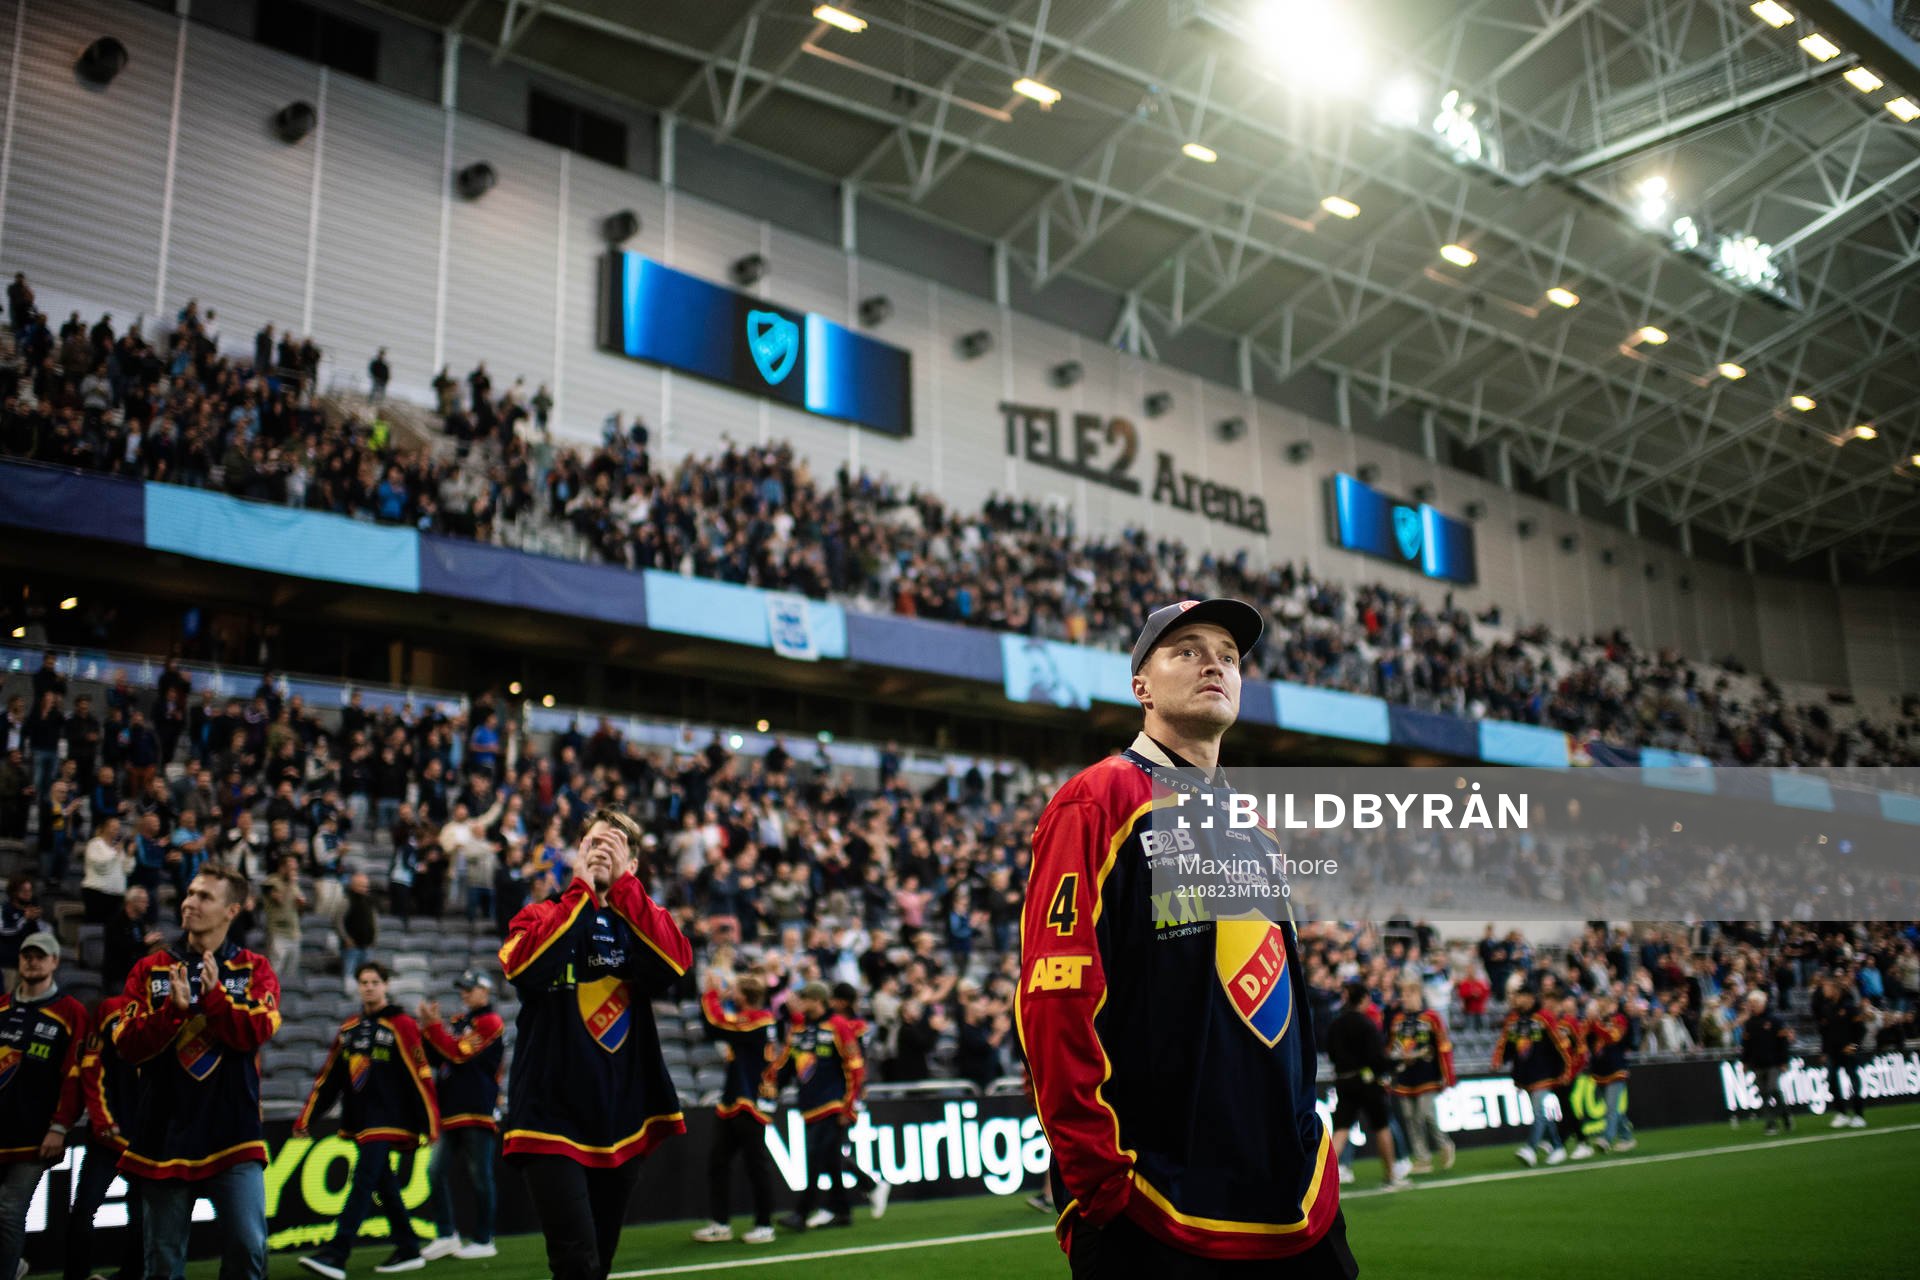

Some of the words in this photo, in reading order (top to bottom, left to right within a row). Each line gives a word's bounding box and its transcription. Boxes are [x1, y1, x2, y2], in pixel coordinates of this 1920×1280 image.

[998, 401, 1142, 495] TELE2
[1152, 453, 1270, 536] Arena
[1139, 829, 1195, 857] B2B
[1046, 872, 1079, 937] 4
[1150, 887, 1212, 930] XXL
[1027, 955, 1093, 994] ABT
[764, 1101, 1052, 1195] Nturliga
